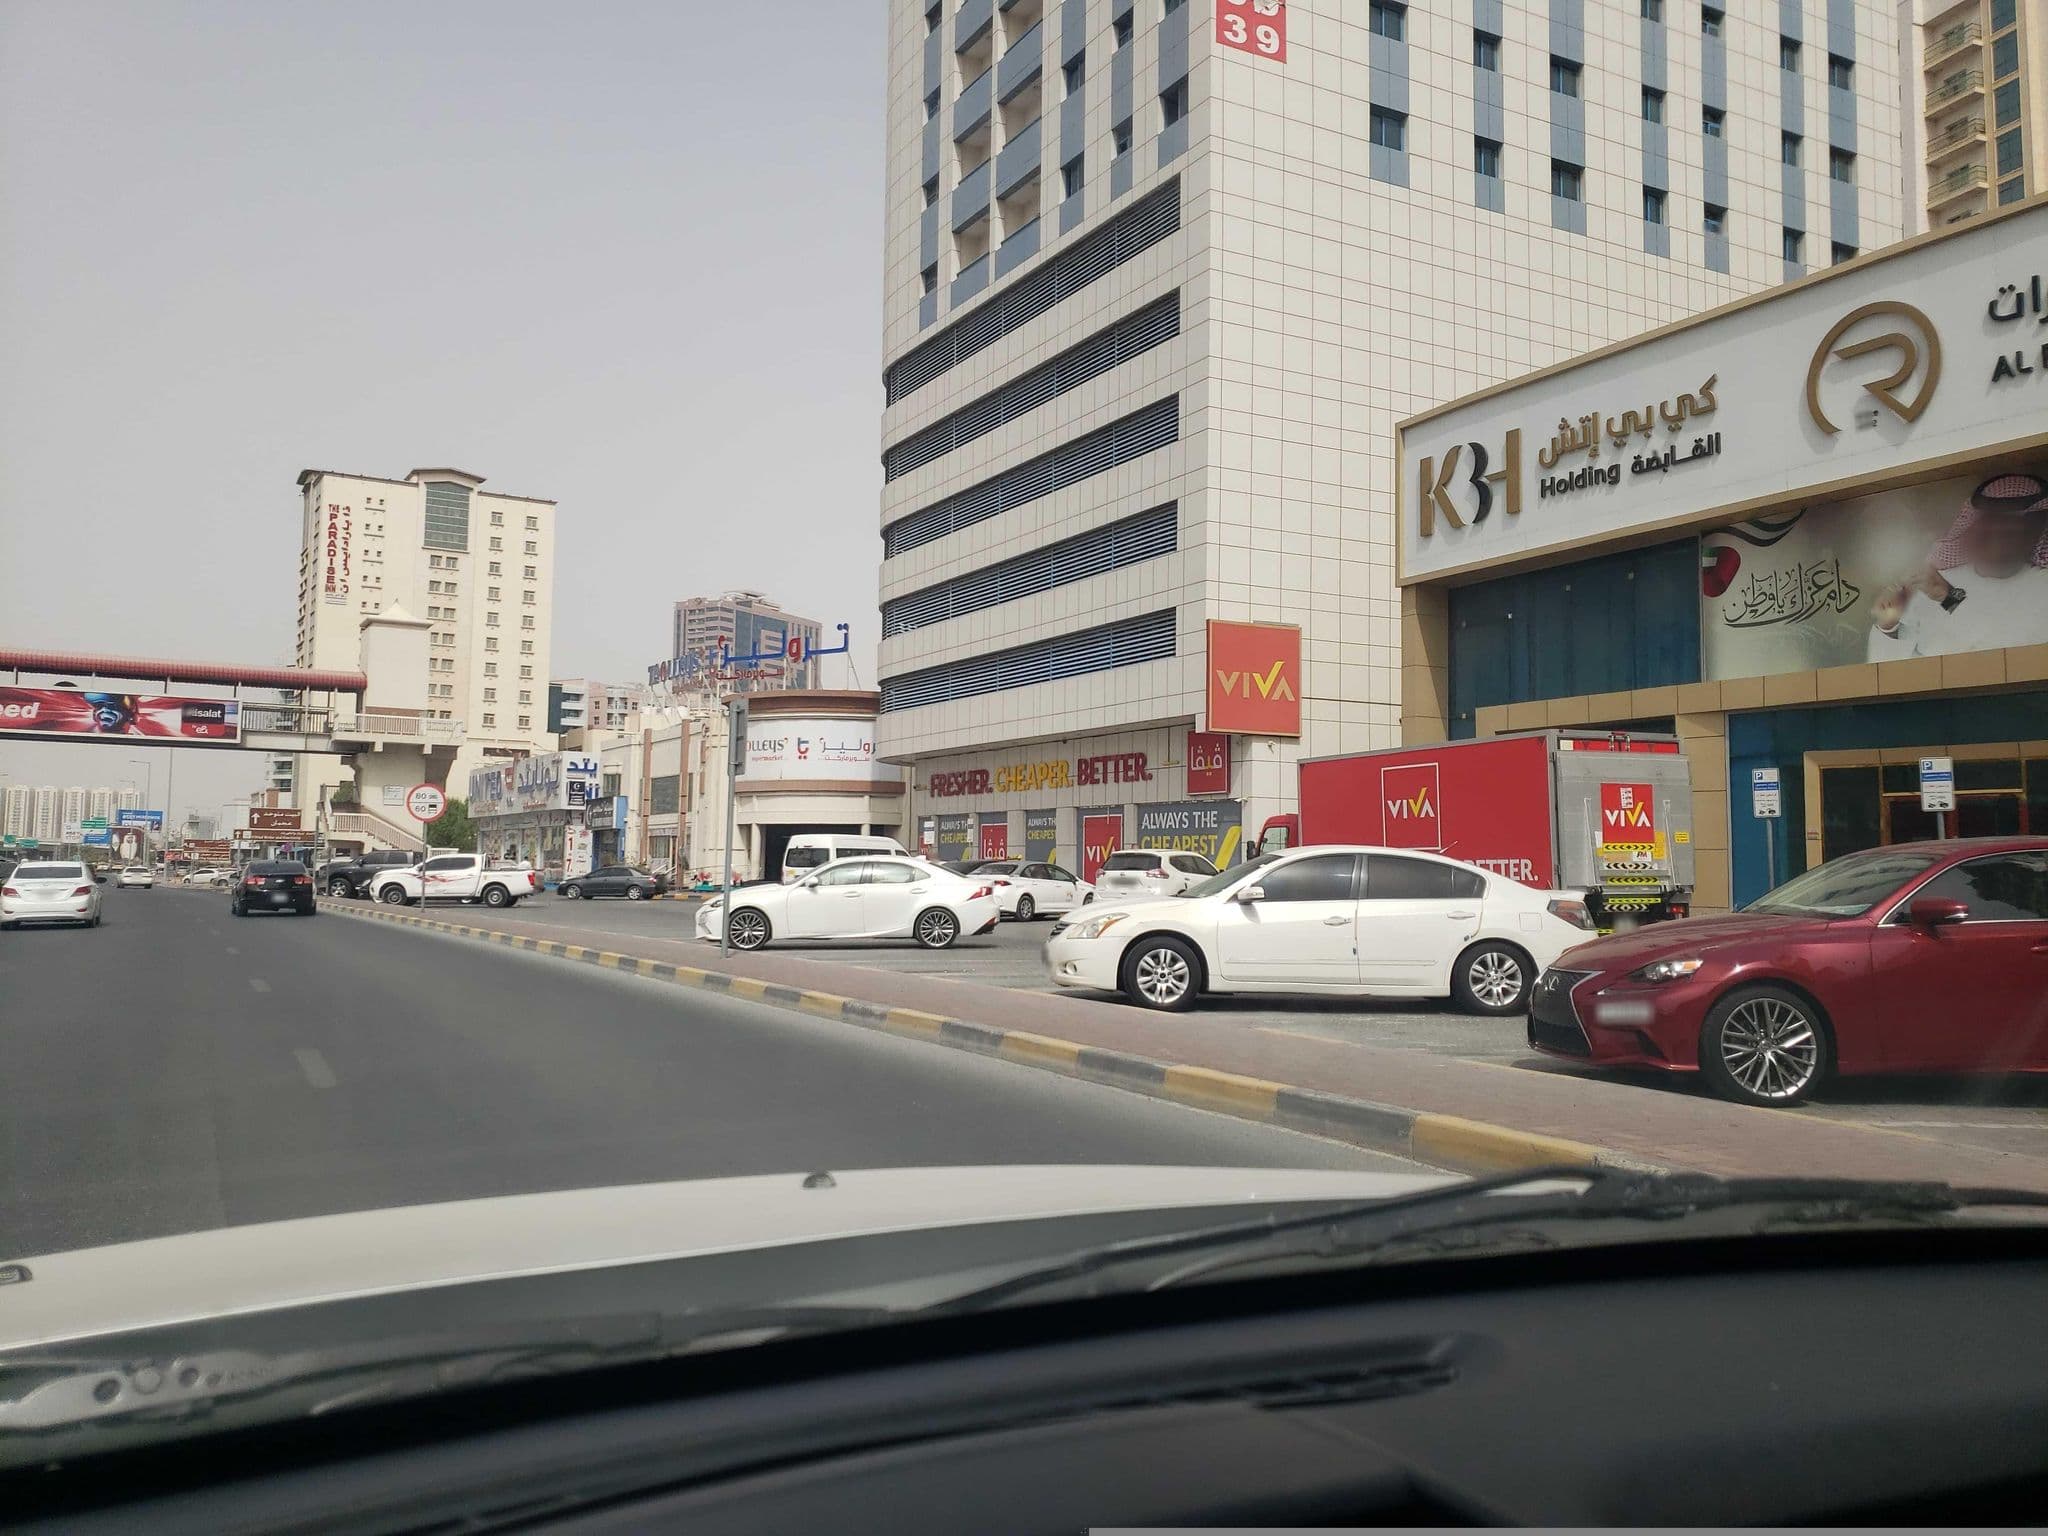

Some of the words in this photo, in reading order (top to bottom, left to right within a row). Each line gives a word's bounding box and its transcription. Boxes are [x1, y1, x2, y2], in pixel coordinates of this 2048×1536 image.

[1223, 14, 1280, 54] 39
[1992, 350, 2034, 382] AL
[1659, 373, 1718, 432] كي
[1539, 412, 1601, 469] إتش
[1606, 405, 1654, 447] بي
[1420, 428, 1521, 537] KBH
[1540, 463, 1621, 499] Holding
[327, 513, 338, 584] PARADISE
[1216, 660, 1296, 702] VIVA
[930, 769, 993, 797] FRESHER.
[995, 760, 1073, 793] CHEAPER.
[1077, 752, 1153, 785] BETTER.
[1142, 812, 1189, 829] ALWAYS
[1193, 811, 1218, 828] THE
[1387, 787, 1435, 819] VIVA
[1604, 802, 1651, 827] VIVA
[941, 833, 968, 844] CHEAPES
[1086, 836, 1117, 863] VIV
[1141, 835, 1218, 856] CHEAPEST
